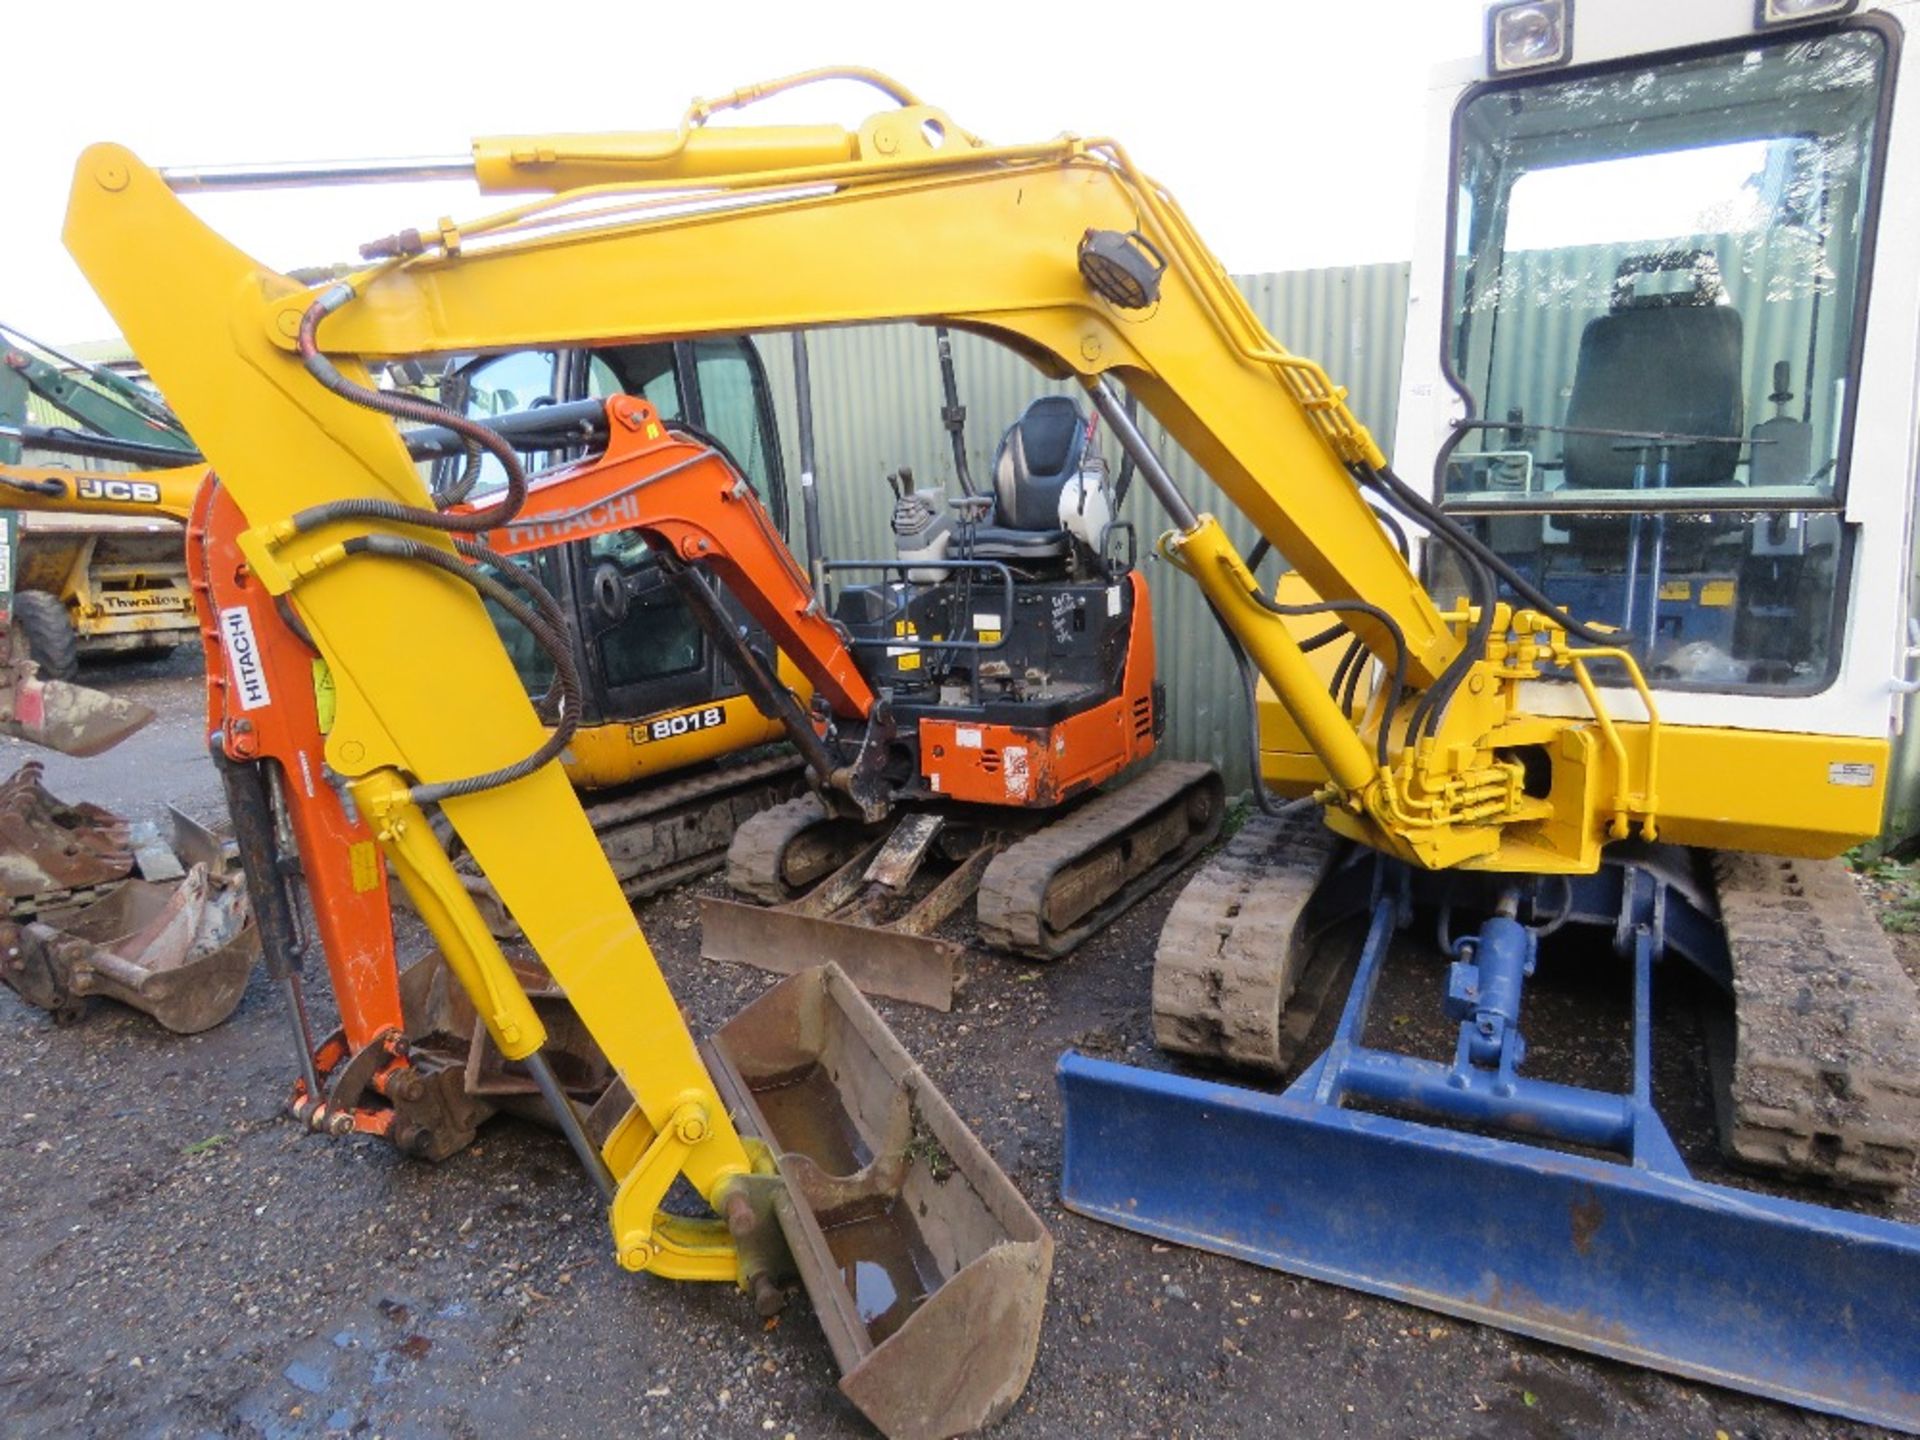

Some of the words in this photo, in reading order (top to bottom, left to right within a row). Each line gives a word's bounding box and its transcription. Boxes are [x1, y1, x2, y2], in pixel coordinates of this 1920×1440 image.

[81, 480, 158, 502] JCB
[508, 495, 639, 544] HITACHI
[228, 613, 262, 702] HITACHI
[653, 708, 721, 739] 8018
